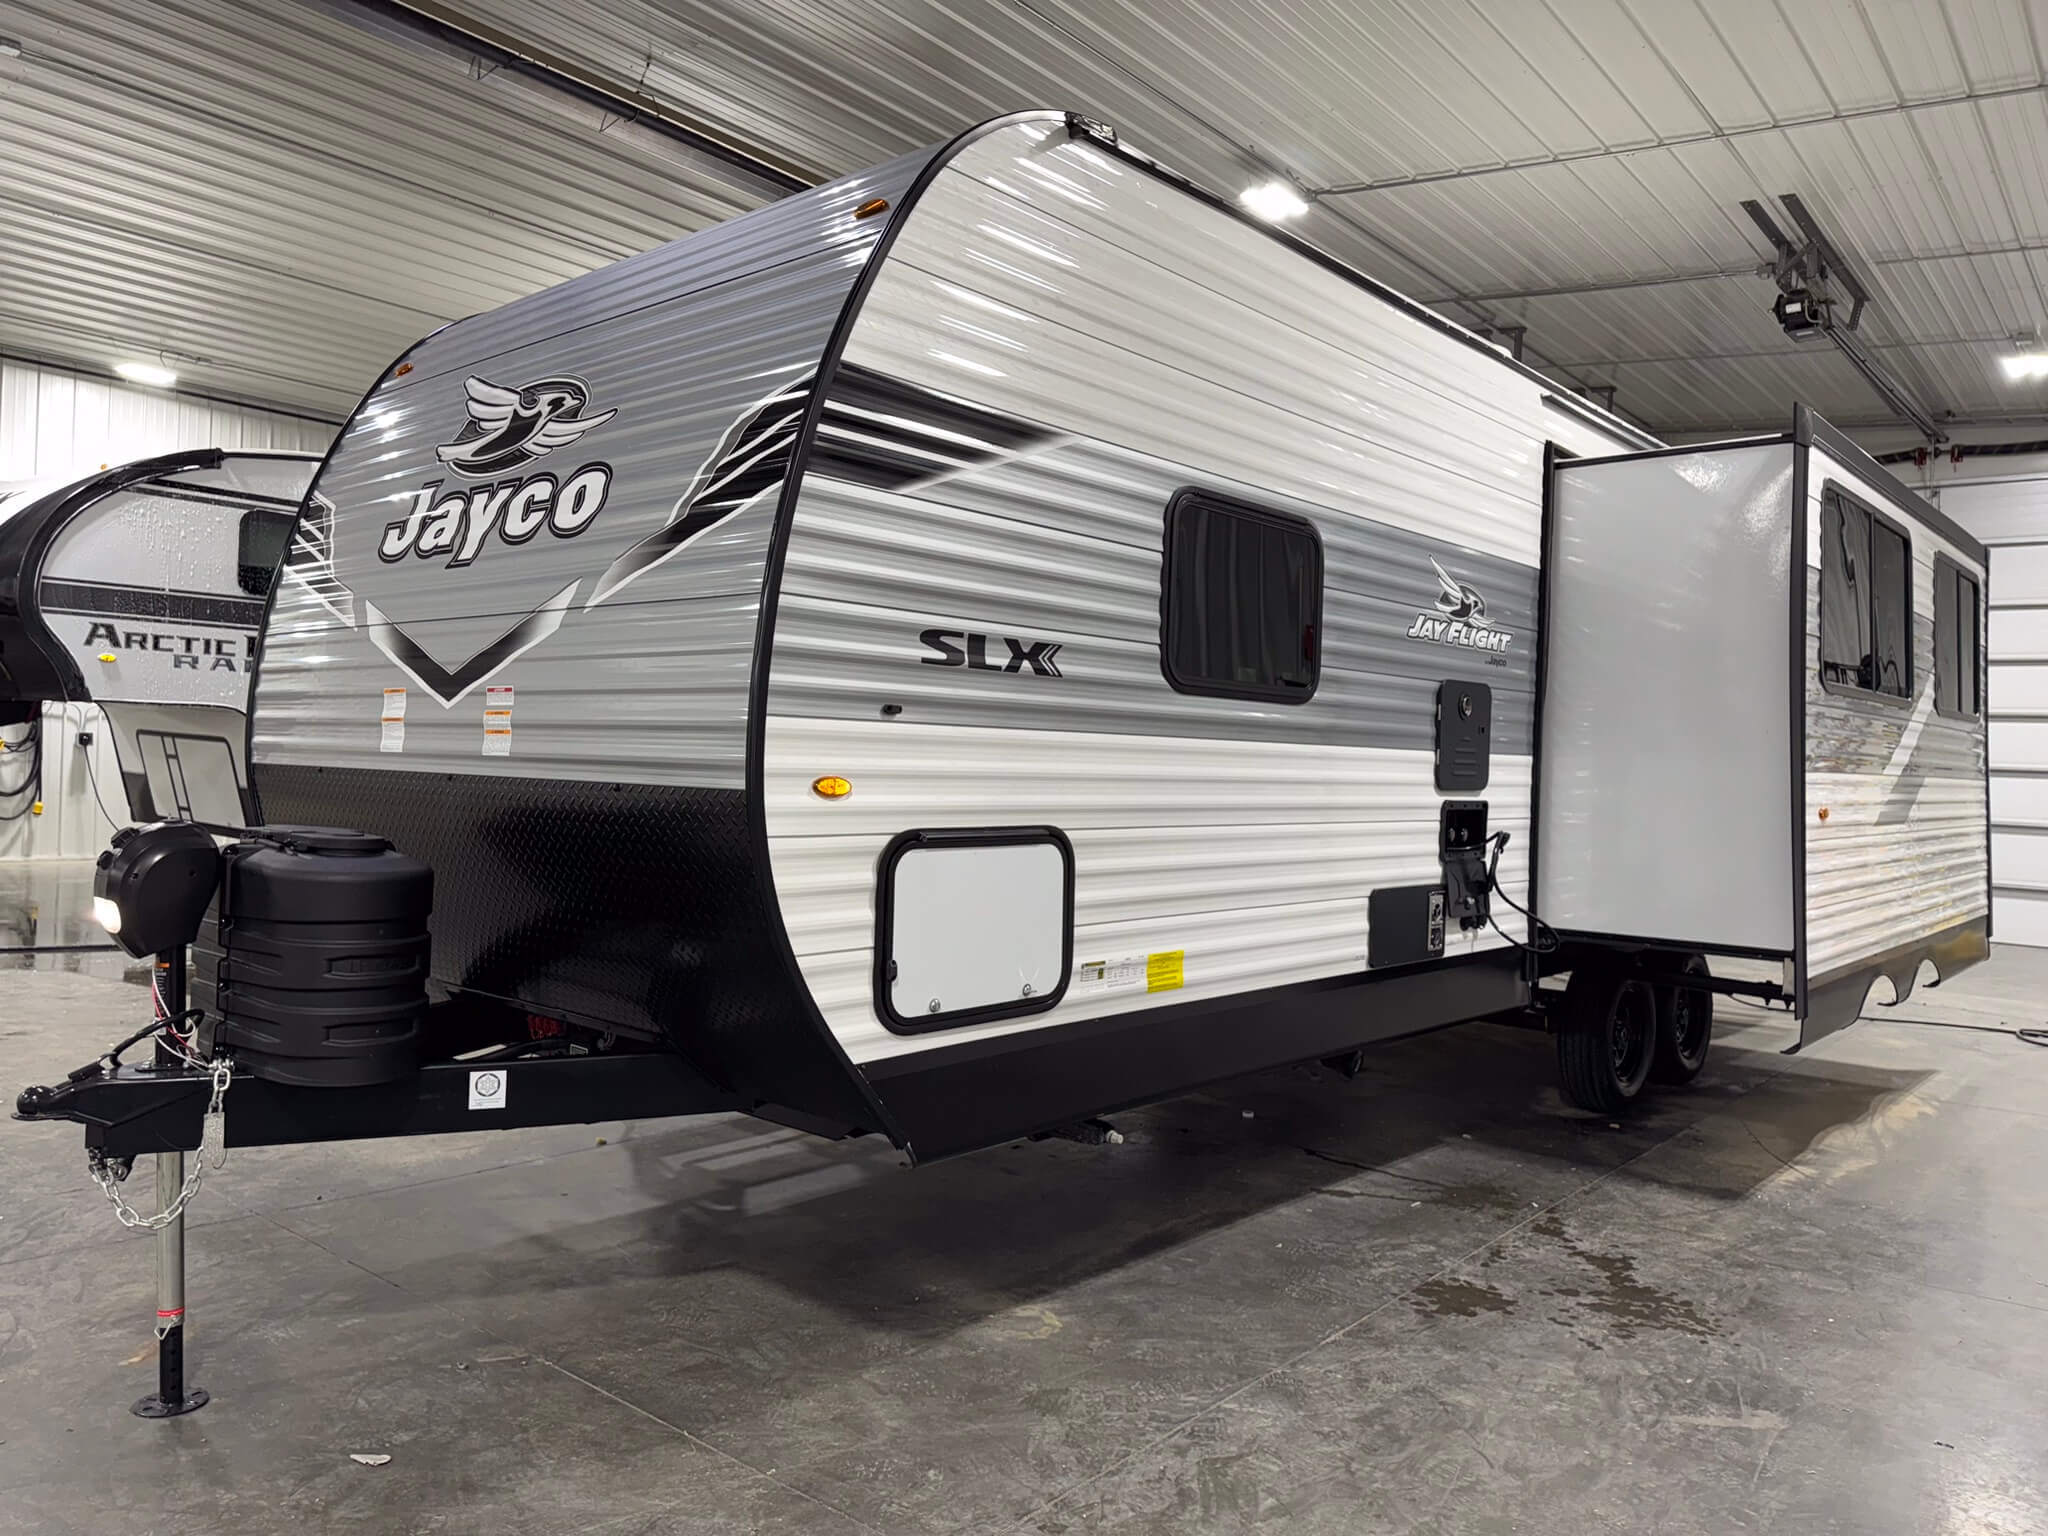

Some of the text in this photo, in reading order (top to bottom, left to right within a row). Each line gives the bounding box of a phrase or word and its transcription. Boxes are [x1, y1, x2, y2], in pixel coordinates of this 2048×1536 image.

[378, 461, 613, 569] Jayco
[83, 622, 237, 657] ARCTIC
[920, 629, 1063, 677] SLX
[1407, 613, 1513, 653] JAY FLIGHT
